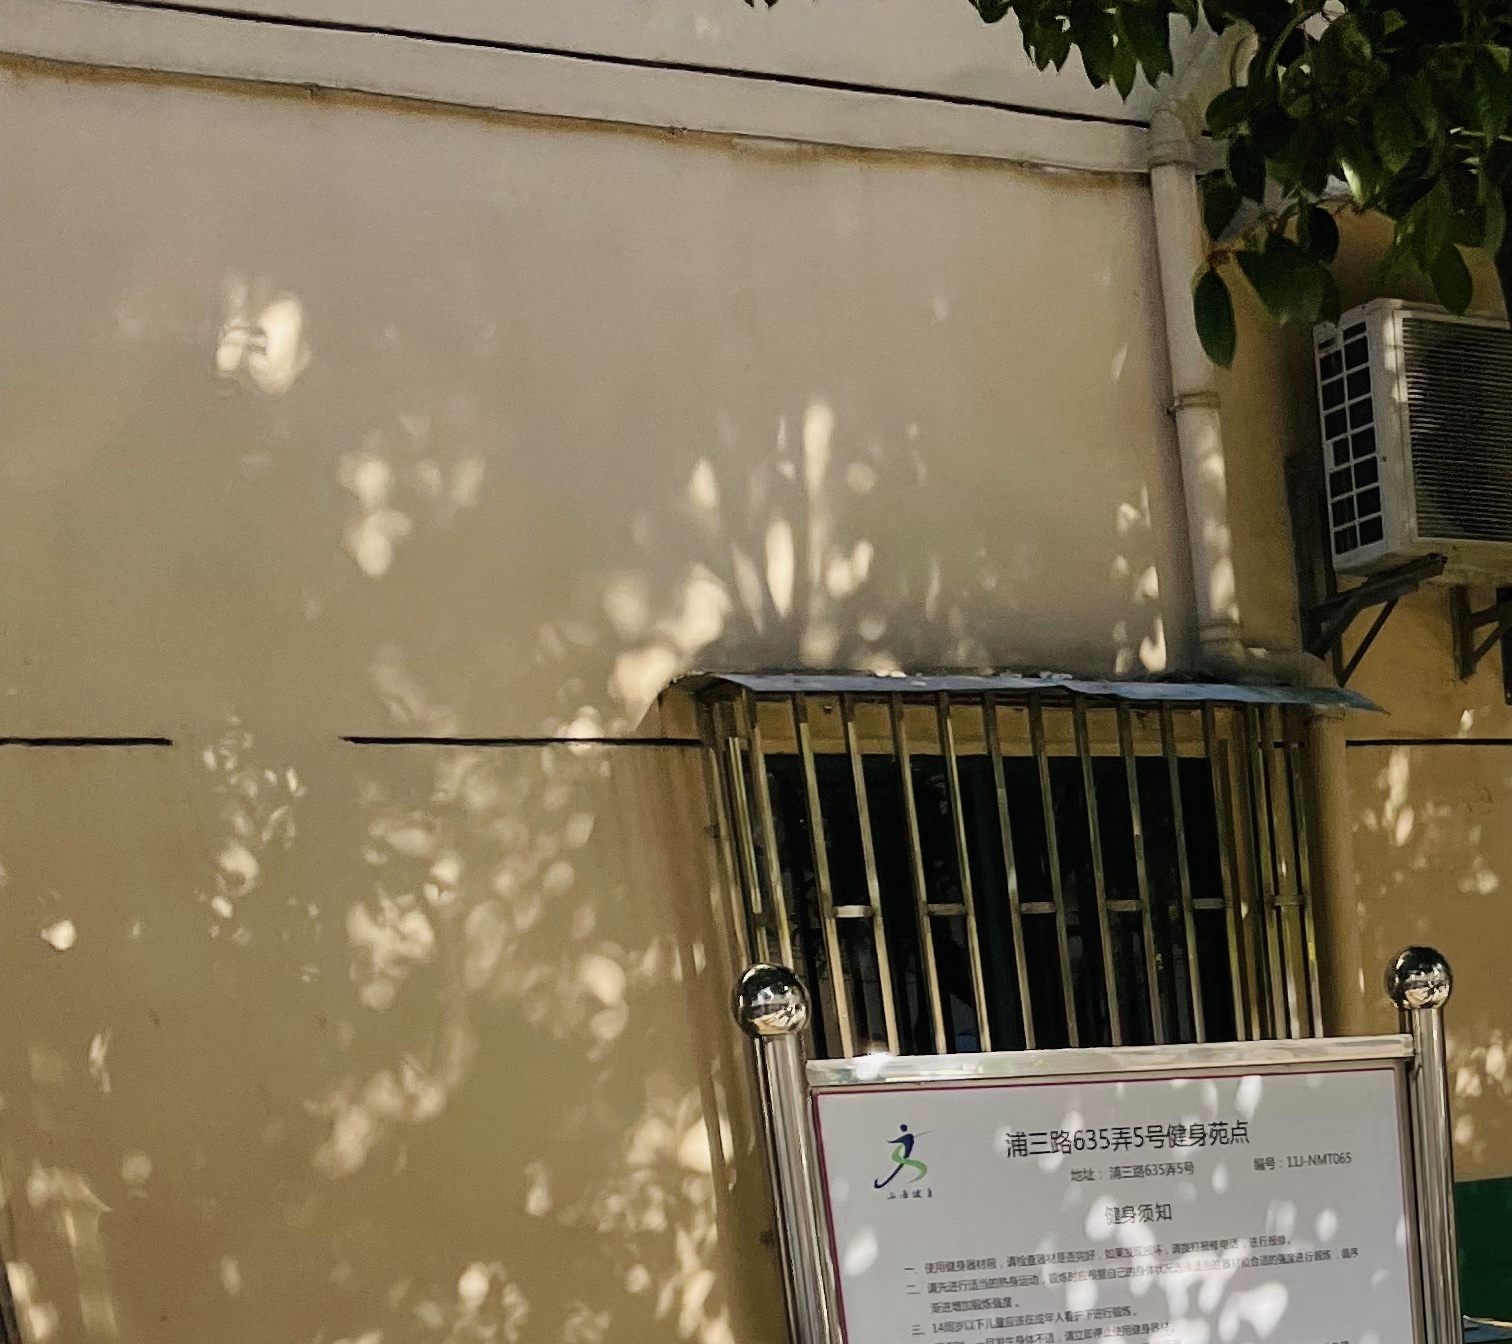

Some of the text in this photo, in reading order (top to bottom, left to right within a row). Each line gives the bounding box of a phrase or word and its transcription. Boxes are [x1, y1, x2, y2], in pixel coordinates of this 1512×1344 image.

[1006, 1120, 1250, 1157] 浦三路635弄5号健身苑点
[1105, 1203, 1172, 1225] 健身须知
